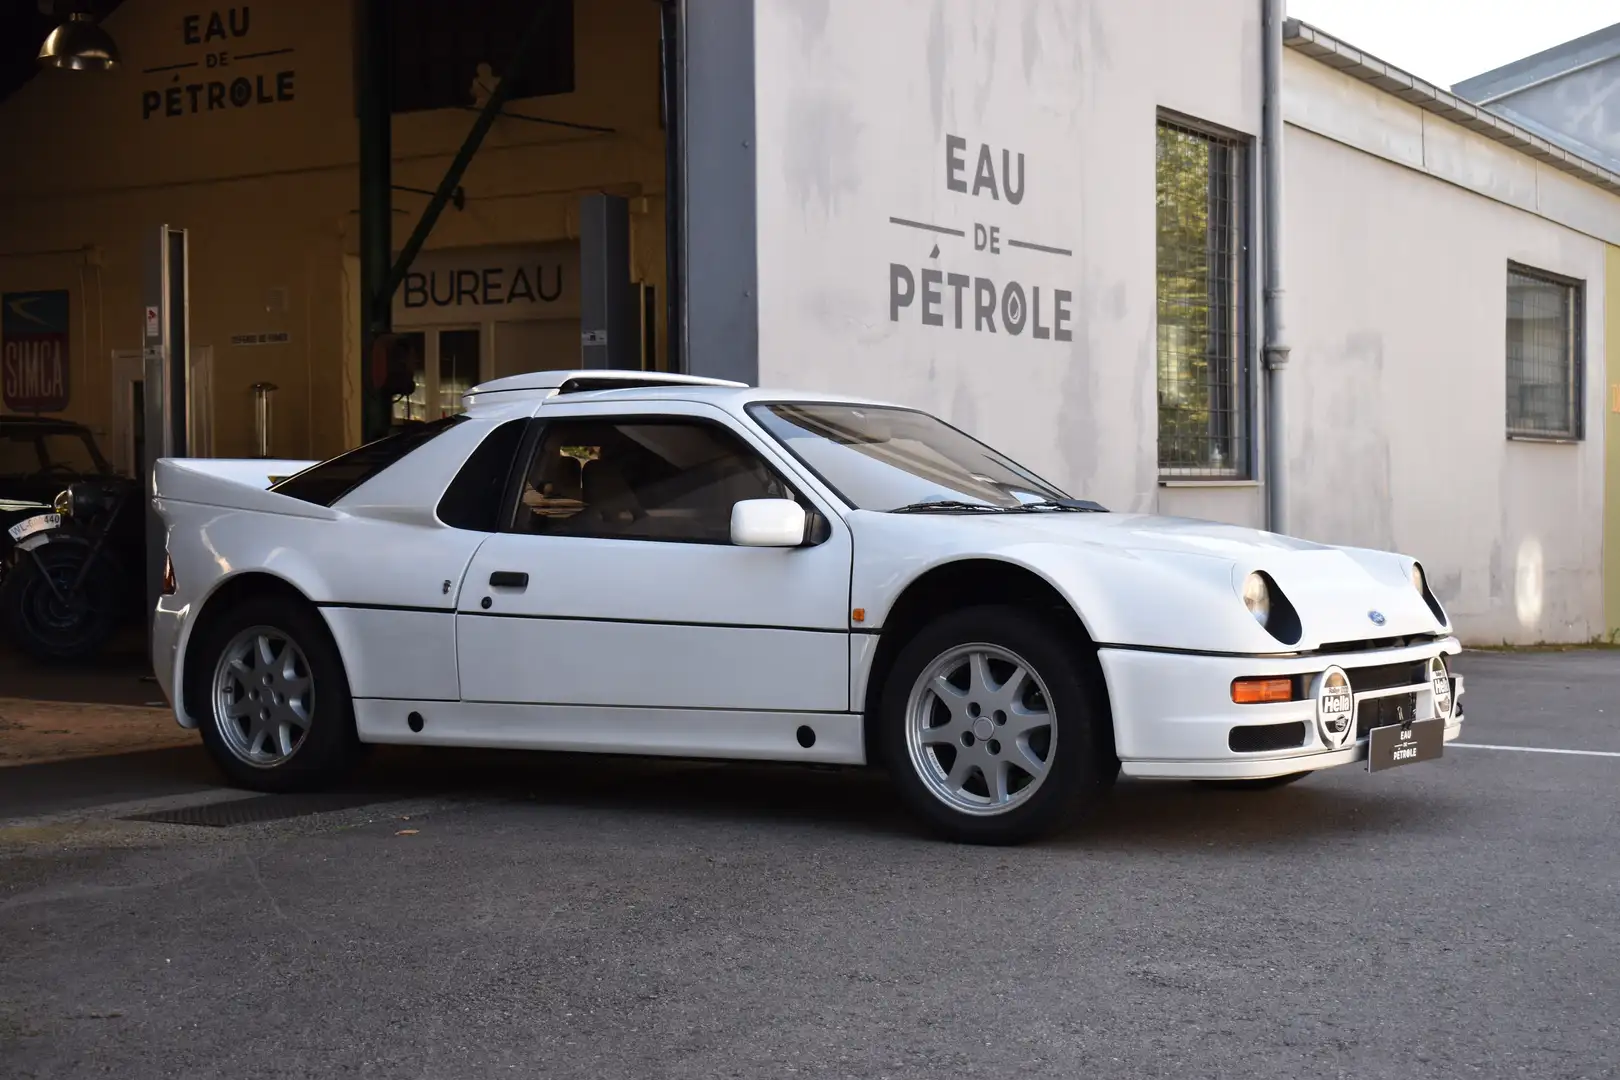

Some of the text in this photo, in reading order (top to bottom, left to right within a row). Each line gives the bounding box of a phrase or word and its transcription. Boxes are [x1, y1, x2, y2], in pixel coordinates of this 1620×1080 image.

[183, 6, 250, 45] EAU
[205, 51, 229, 68] DE
[142, 70, 295, 119] PÉTROLE
[946, 133, 1025, 206] EAU
[974, 222, 1000, 255] DE
[404, 264, 562, 308] BUREAU
[889, 243, 1073, 342] PÉTROLE
[5, 341, 64, 398] SIMCA
[44, 515, 60, 524] 440
[1324, 694, 1350, 713] Hella
[1400, 730, 1412, 741] EAU
